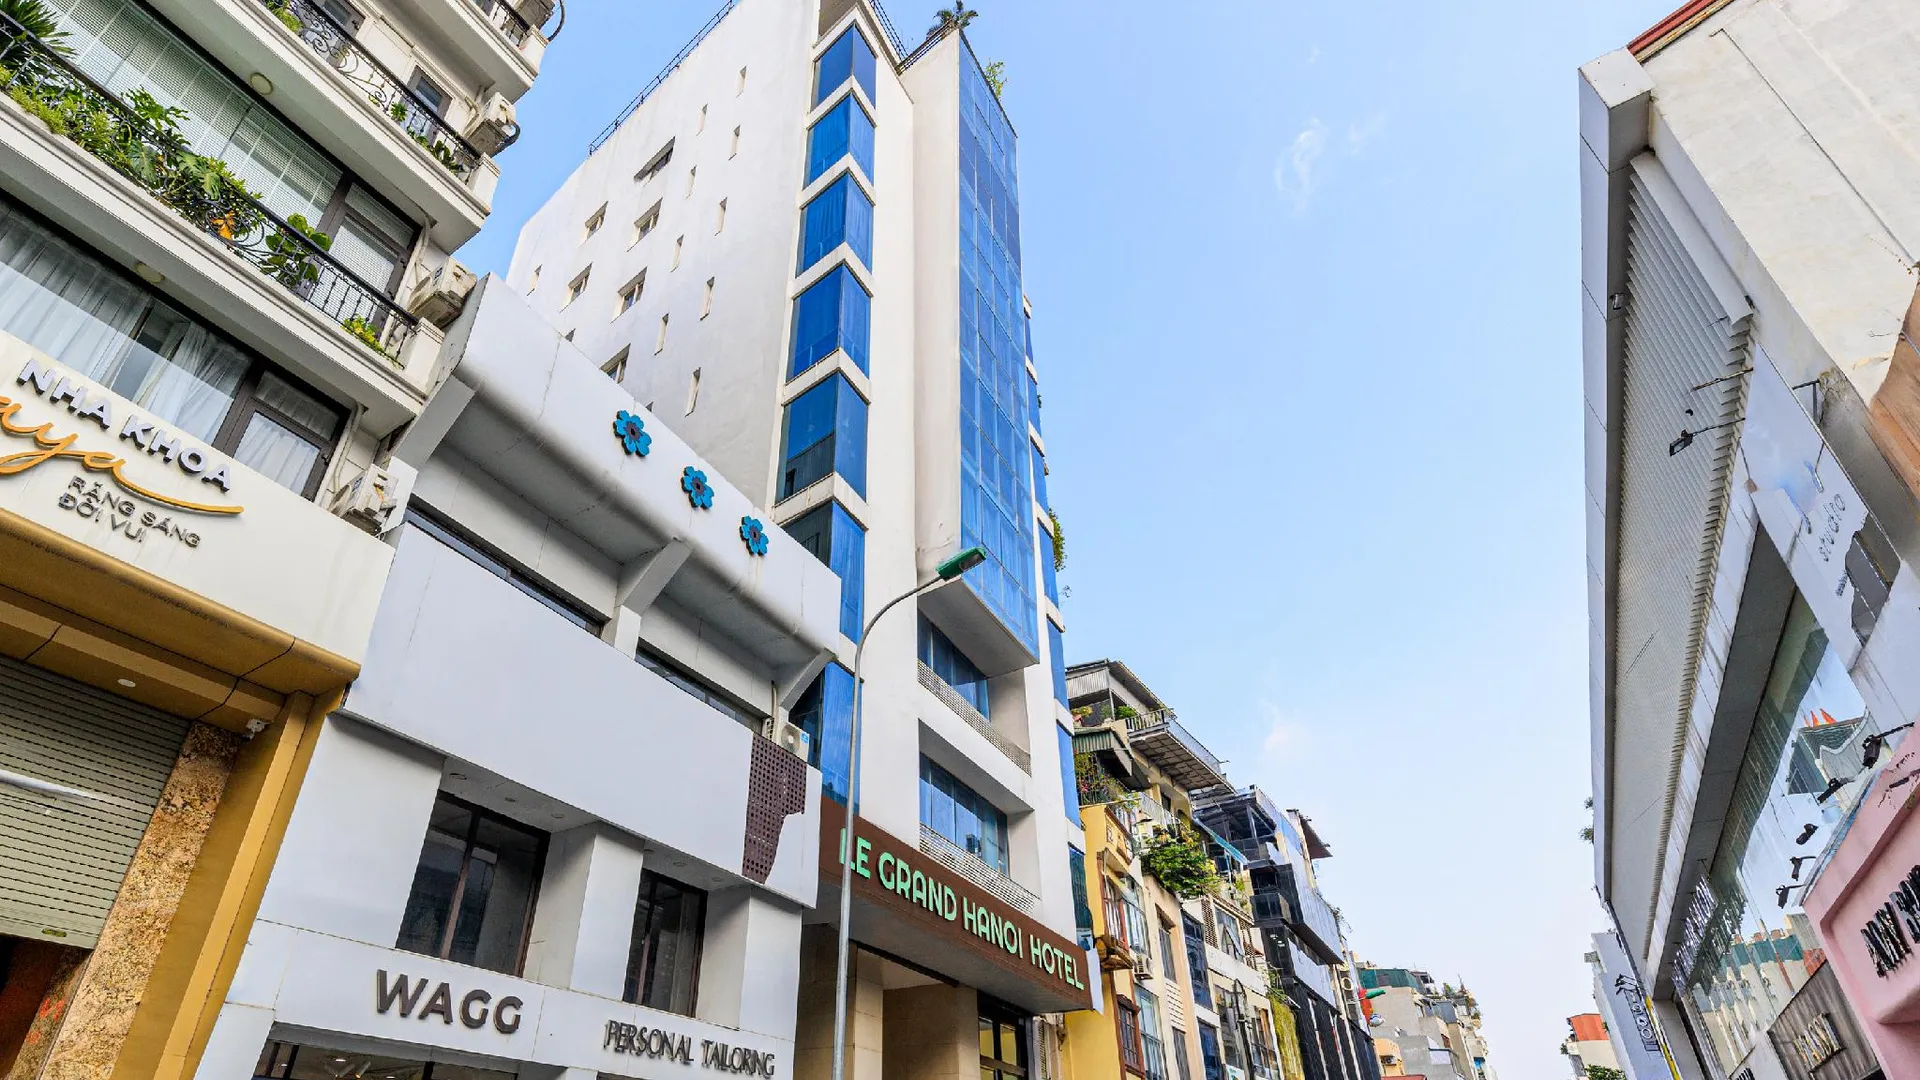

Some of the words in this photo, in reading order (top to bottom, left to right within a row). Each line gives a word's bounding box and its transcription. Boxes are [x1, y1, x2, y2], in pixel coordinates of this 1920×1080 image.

[16, 358, 112, 430] NHA
[119, 413, 232, 493] KHOA
[68, 475, 136, 518] RĂNG
[141, 511, 201, 548] SÁNG
[110, 513, 148, 544] VUI
[839, 828, 872, 880] LE
[878, 852, 957, 922] GRAND
[962, 896, 1023, 959] HANOI
[1029, 934, 1085, 990] HOTEL
[377, 969, 524, 1034] WAGG
[603, 1019, 695, 1066] PERSONAL
[701, 1038, 776, 1079] TAILORING
